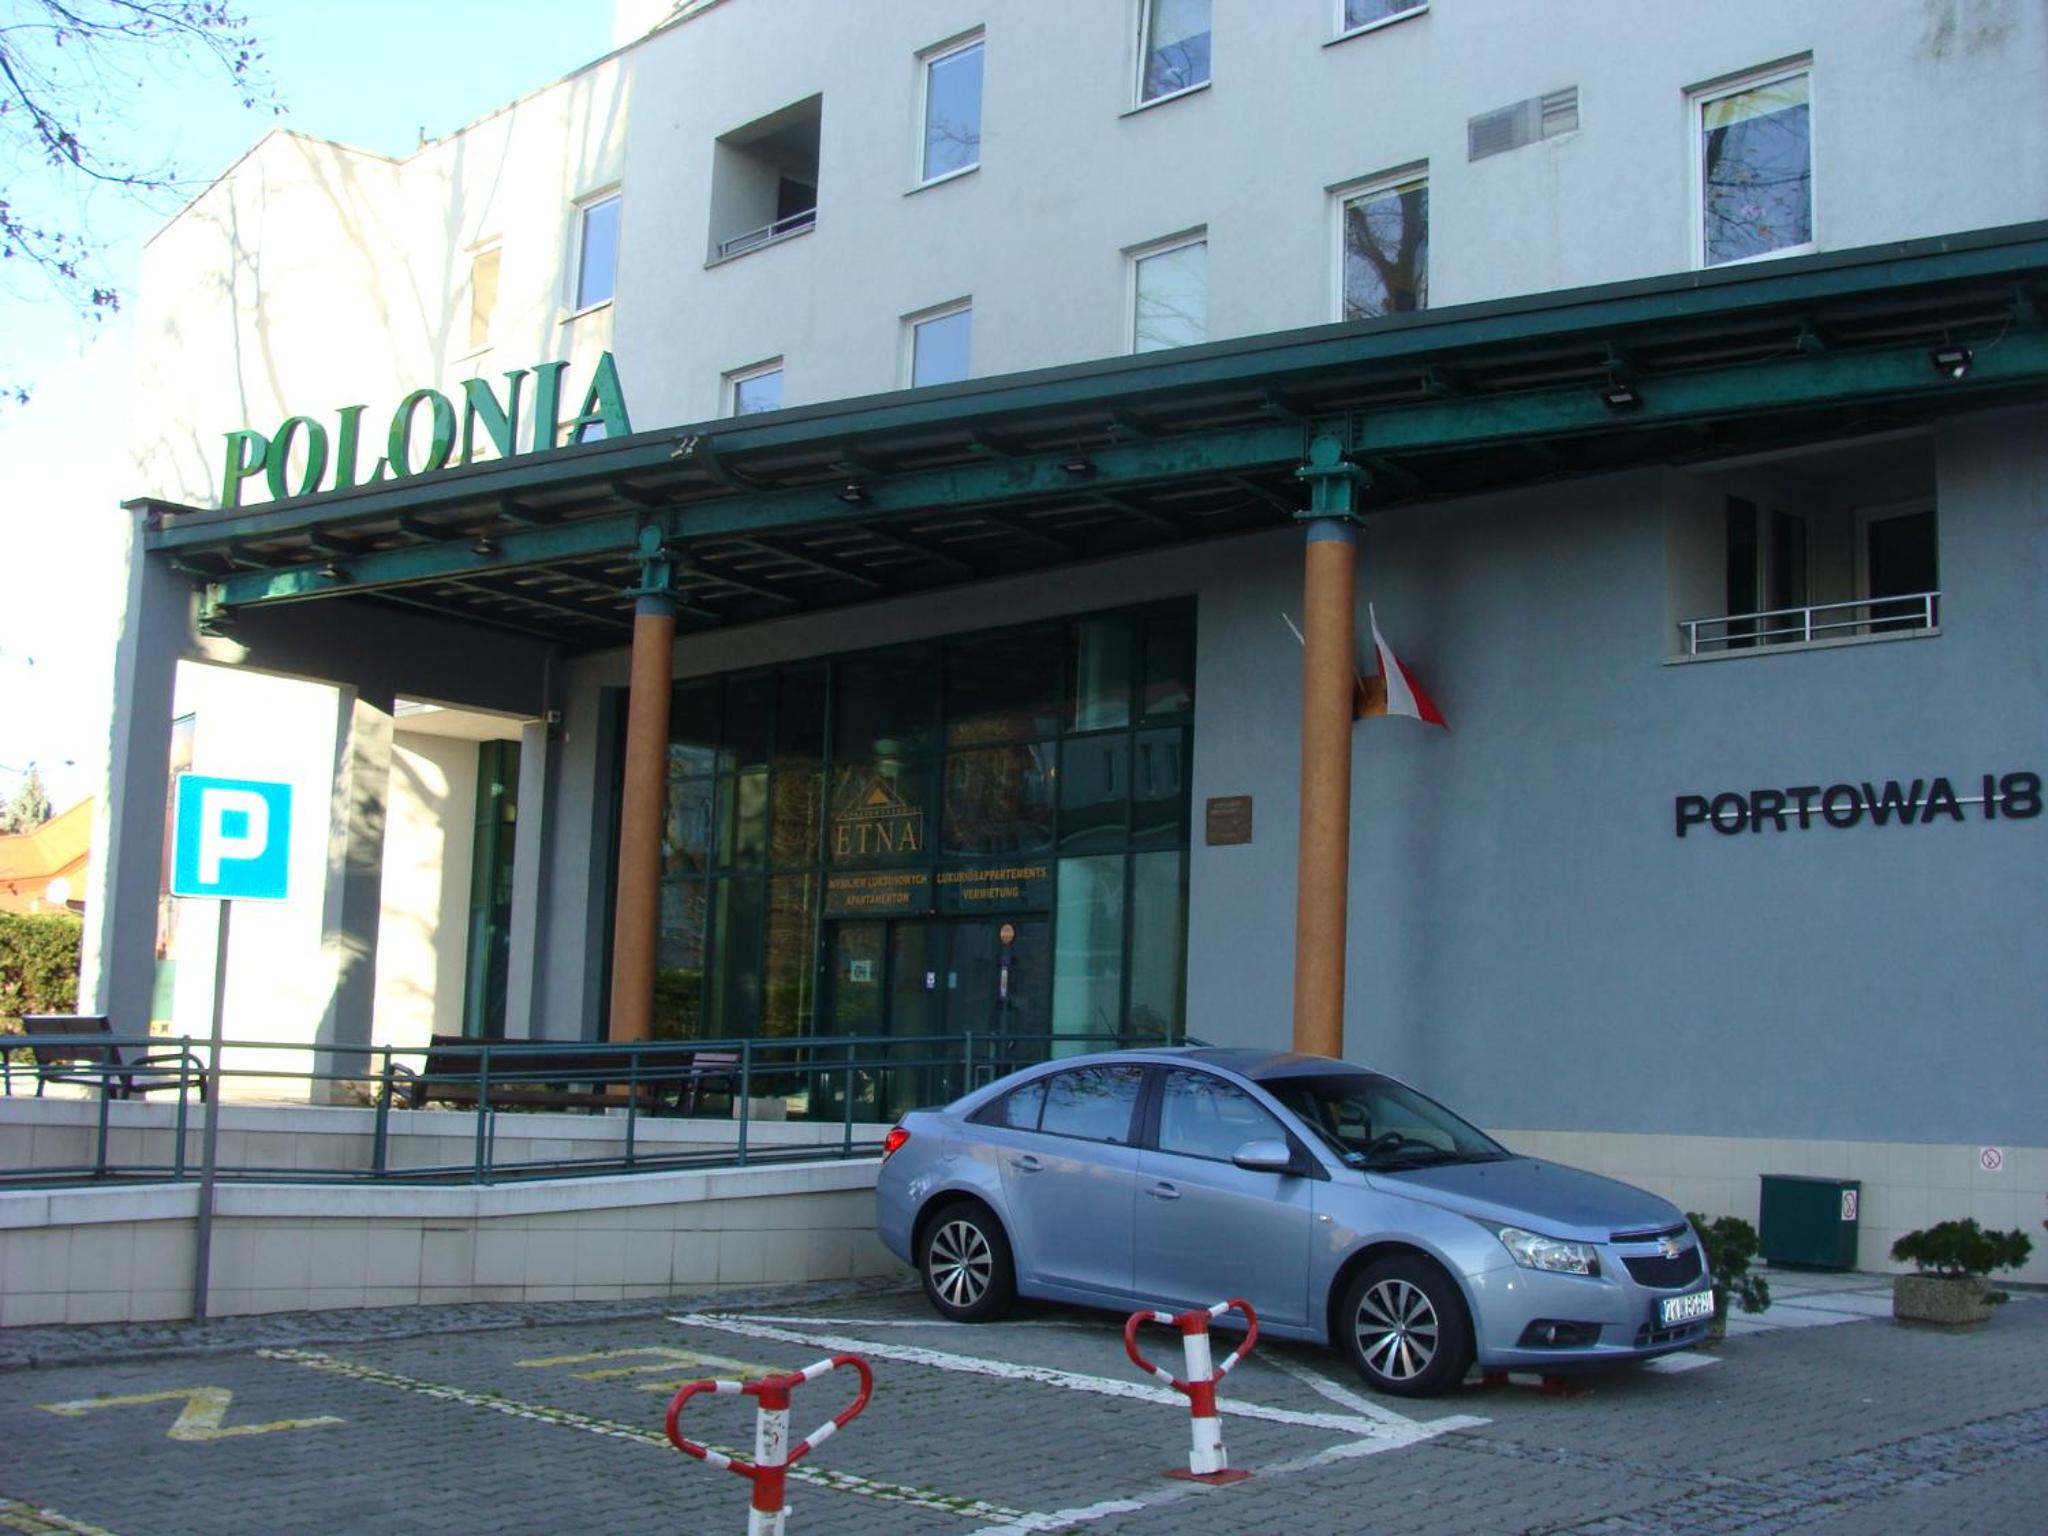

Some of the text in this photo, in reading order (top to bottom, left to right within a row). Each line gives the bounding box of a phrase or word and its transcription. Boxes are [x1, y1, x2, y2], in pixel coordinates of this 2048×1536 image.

[222, 350, 632, 509] POLONIA
[197, 787, 270, 885] P
[836, 820, 917, 855] ETNA
[1675, 771, 2042, 837] PORTOWA 18
